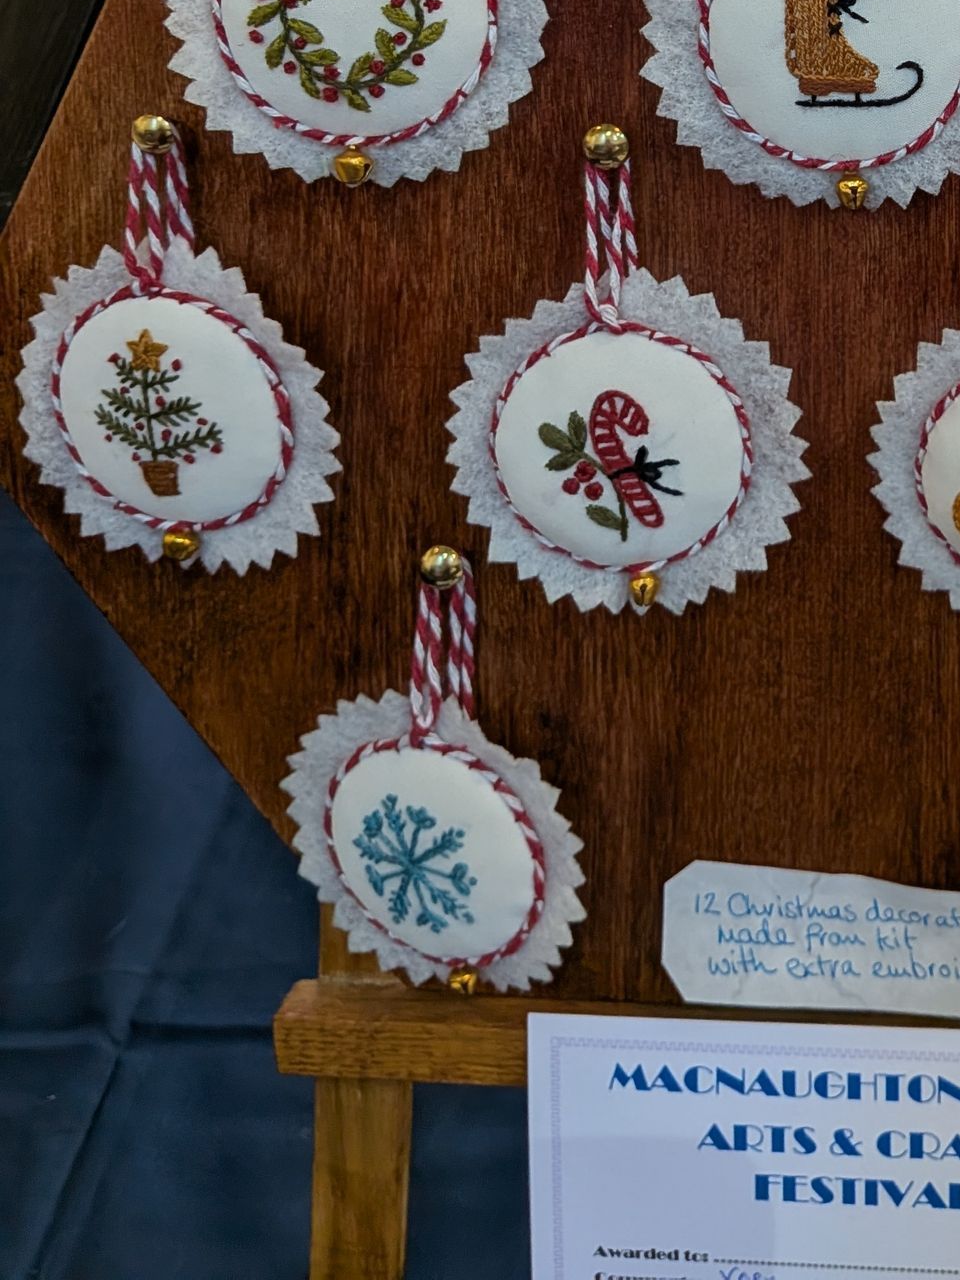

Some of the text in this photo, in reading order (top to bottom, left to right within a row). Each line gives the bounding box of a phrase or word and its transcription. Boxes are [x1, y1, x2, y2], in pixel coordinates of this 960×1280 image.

[694, 892, 721, 915] 12
[727, 891, 858, 923] Christmas
[805, 922, 866, 953] from
[876, 925, 918, 952] kit
[707, 944, 778, 976] with
[785, 953, 861, 979] extra
[697, 1123, 818, 1155] ARTS
[828, 1127, 863, 1156] &
[592, 1245, 680, 1262] Awarded
[683, 1249, 709, 1263] to:
